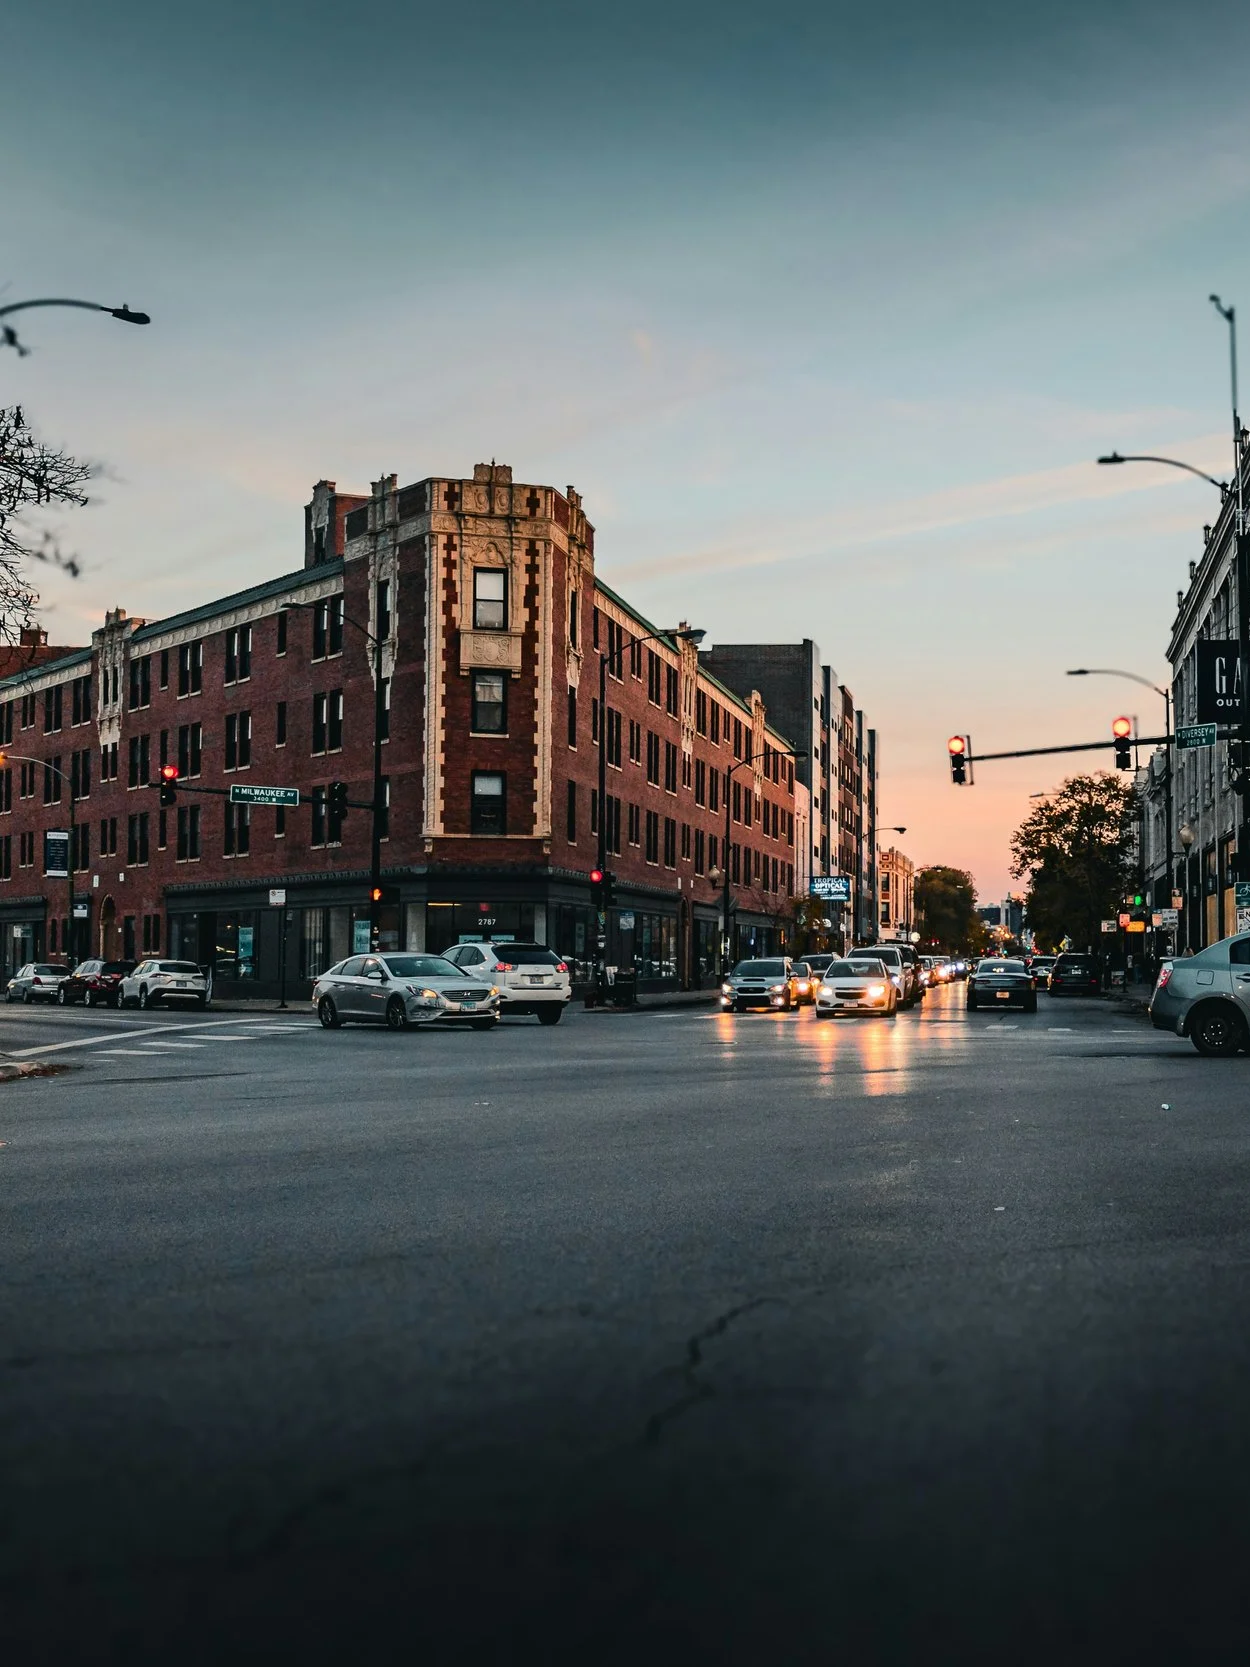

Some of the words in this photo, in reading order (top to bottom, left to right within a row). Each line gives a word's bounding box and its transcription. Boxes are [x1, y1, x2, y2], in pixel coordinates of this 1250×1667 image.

[1181, 728, 1209, 739] DIVERSEY
[241, 788, 285, 797] MILWAUKEE
[478, 918, 496, 926] 2787
